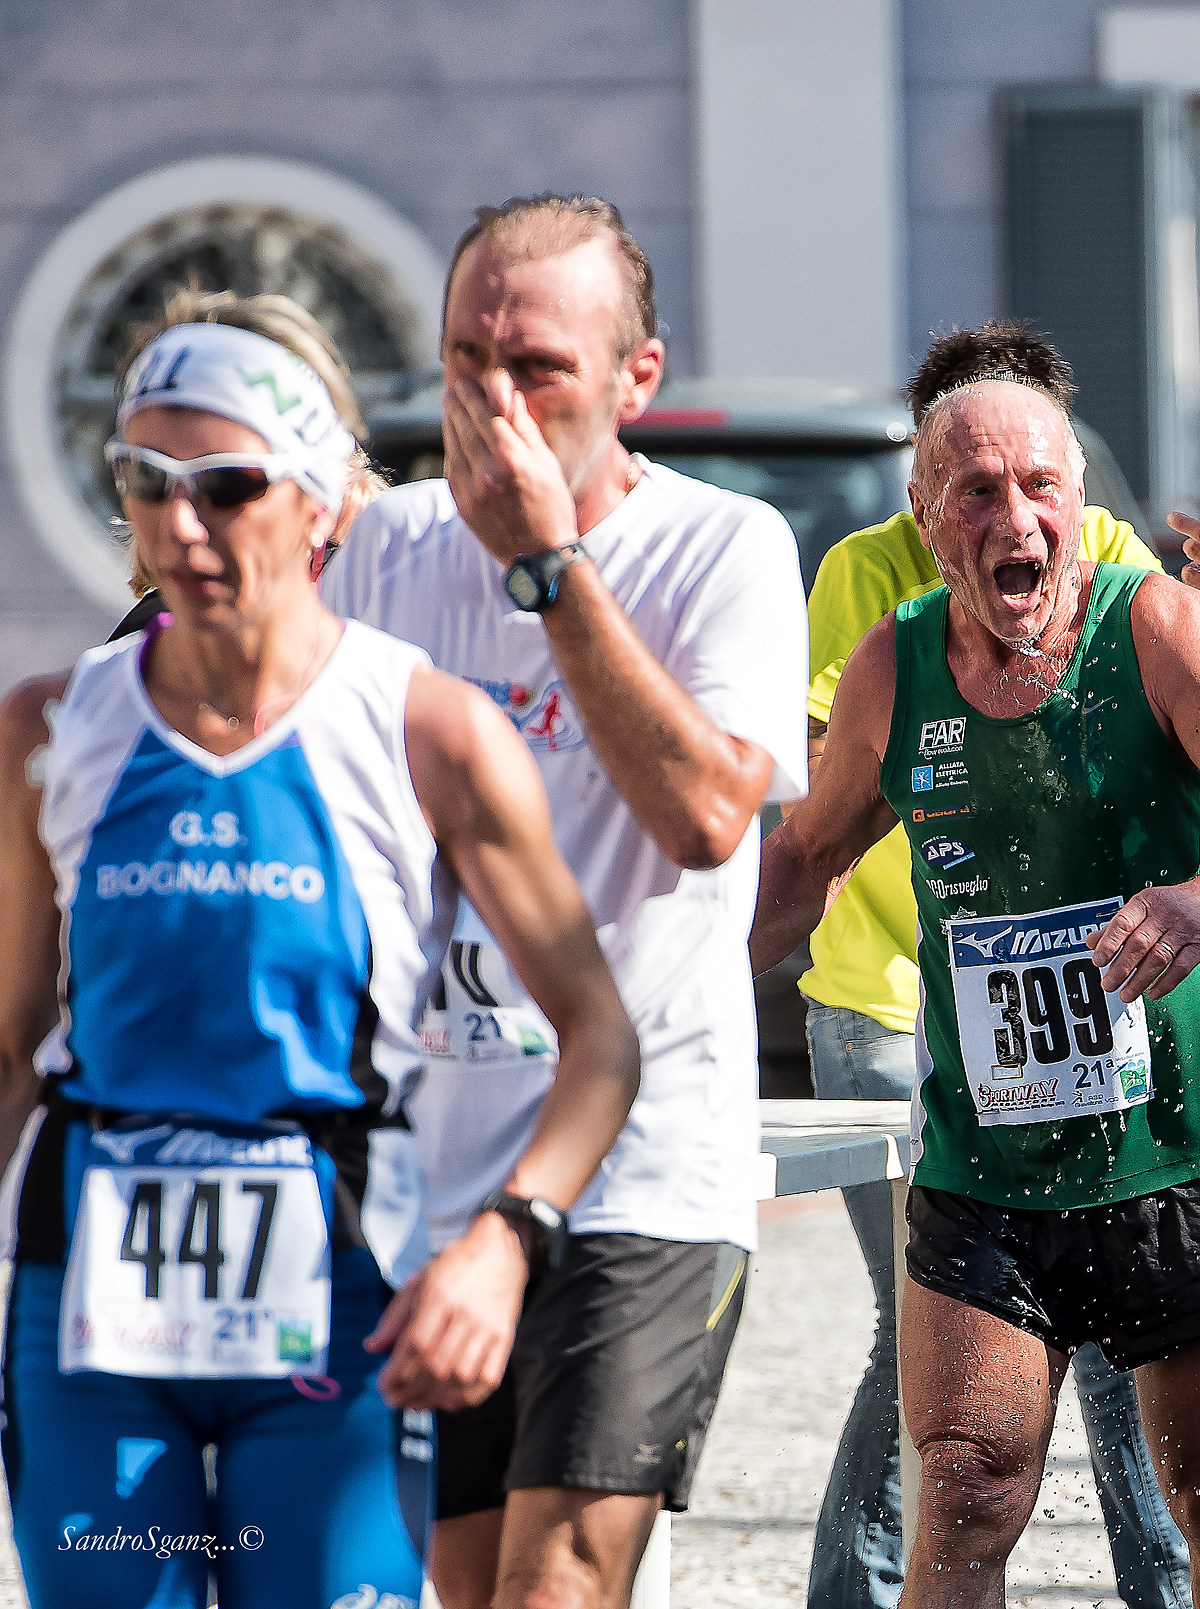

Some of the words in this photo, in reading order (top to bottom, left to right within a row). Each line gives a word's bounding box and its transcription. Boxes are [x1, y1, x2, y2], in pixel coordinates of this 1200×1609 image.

[921, 719, 963, 748] FAR
[169, 810, 248, 847] G.S.
[928, 841, 965, 860] APS
[96, 860, 325, 903] BOGNANCO
[1009, 921, 1110, 955] MIZUN
[987, 958, 1114, 1067] 399
[978, 1078, 1059, 1107] SPORTWAY
[121, 1183, 278, 1299] 447
